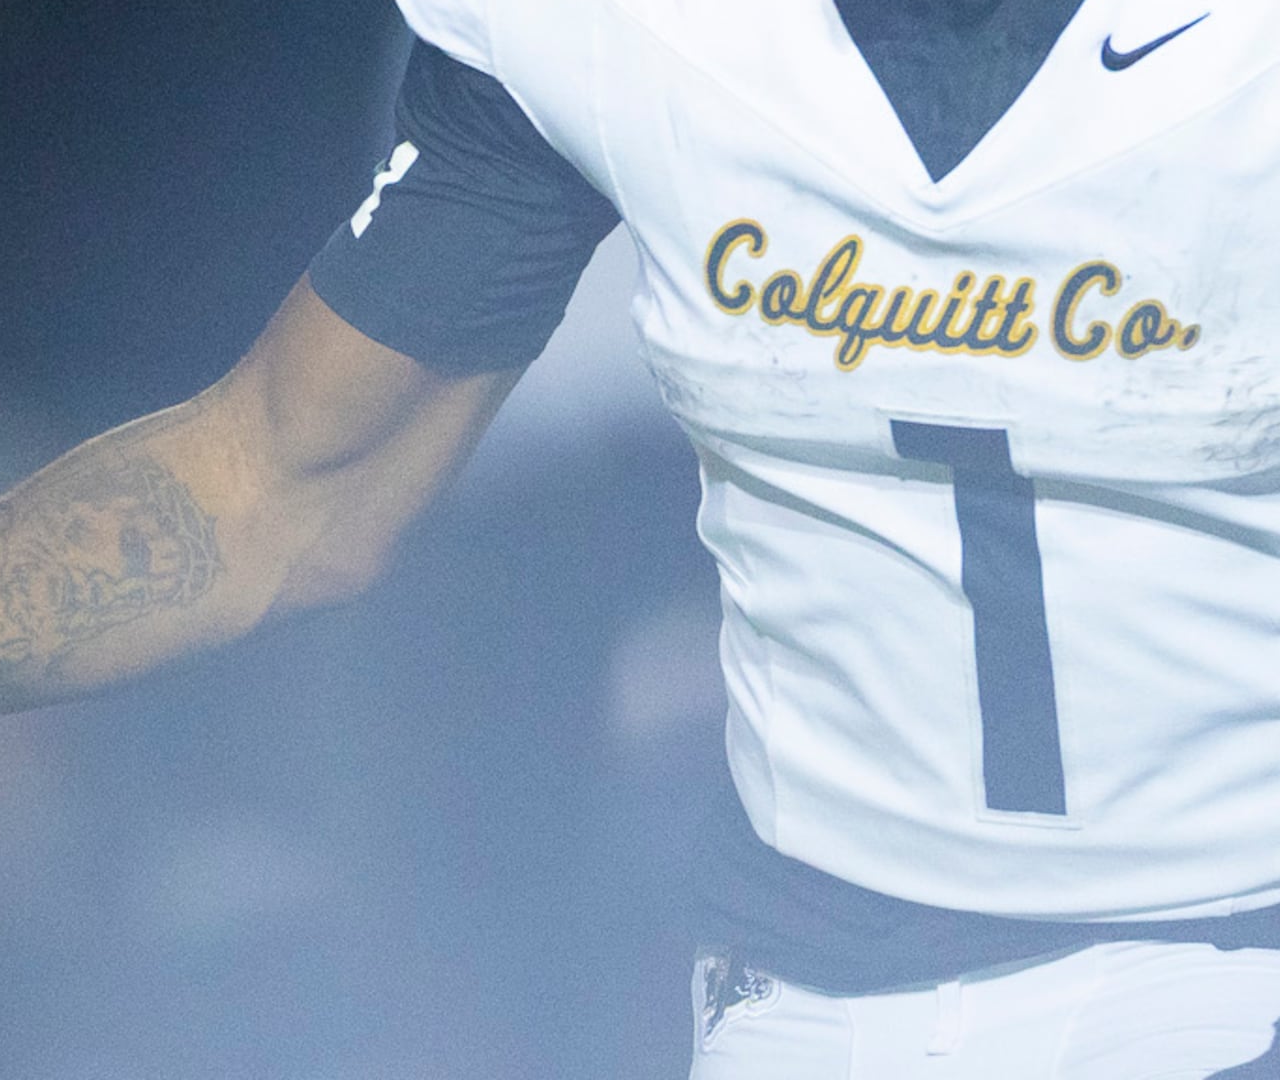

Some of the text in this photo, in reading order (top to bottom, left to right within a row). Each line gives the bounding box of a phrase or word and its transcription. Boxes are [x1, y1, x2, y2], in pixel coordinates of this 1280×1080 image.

[705, 217, 1202, 372] Colquitt Co.
[889, 418, 1068, 817] 1
